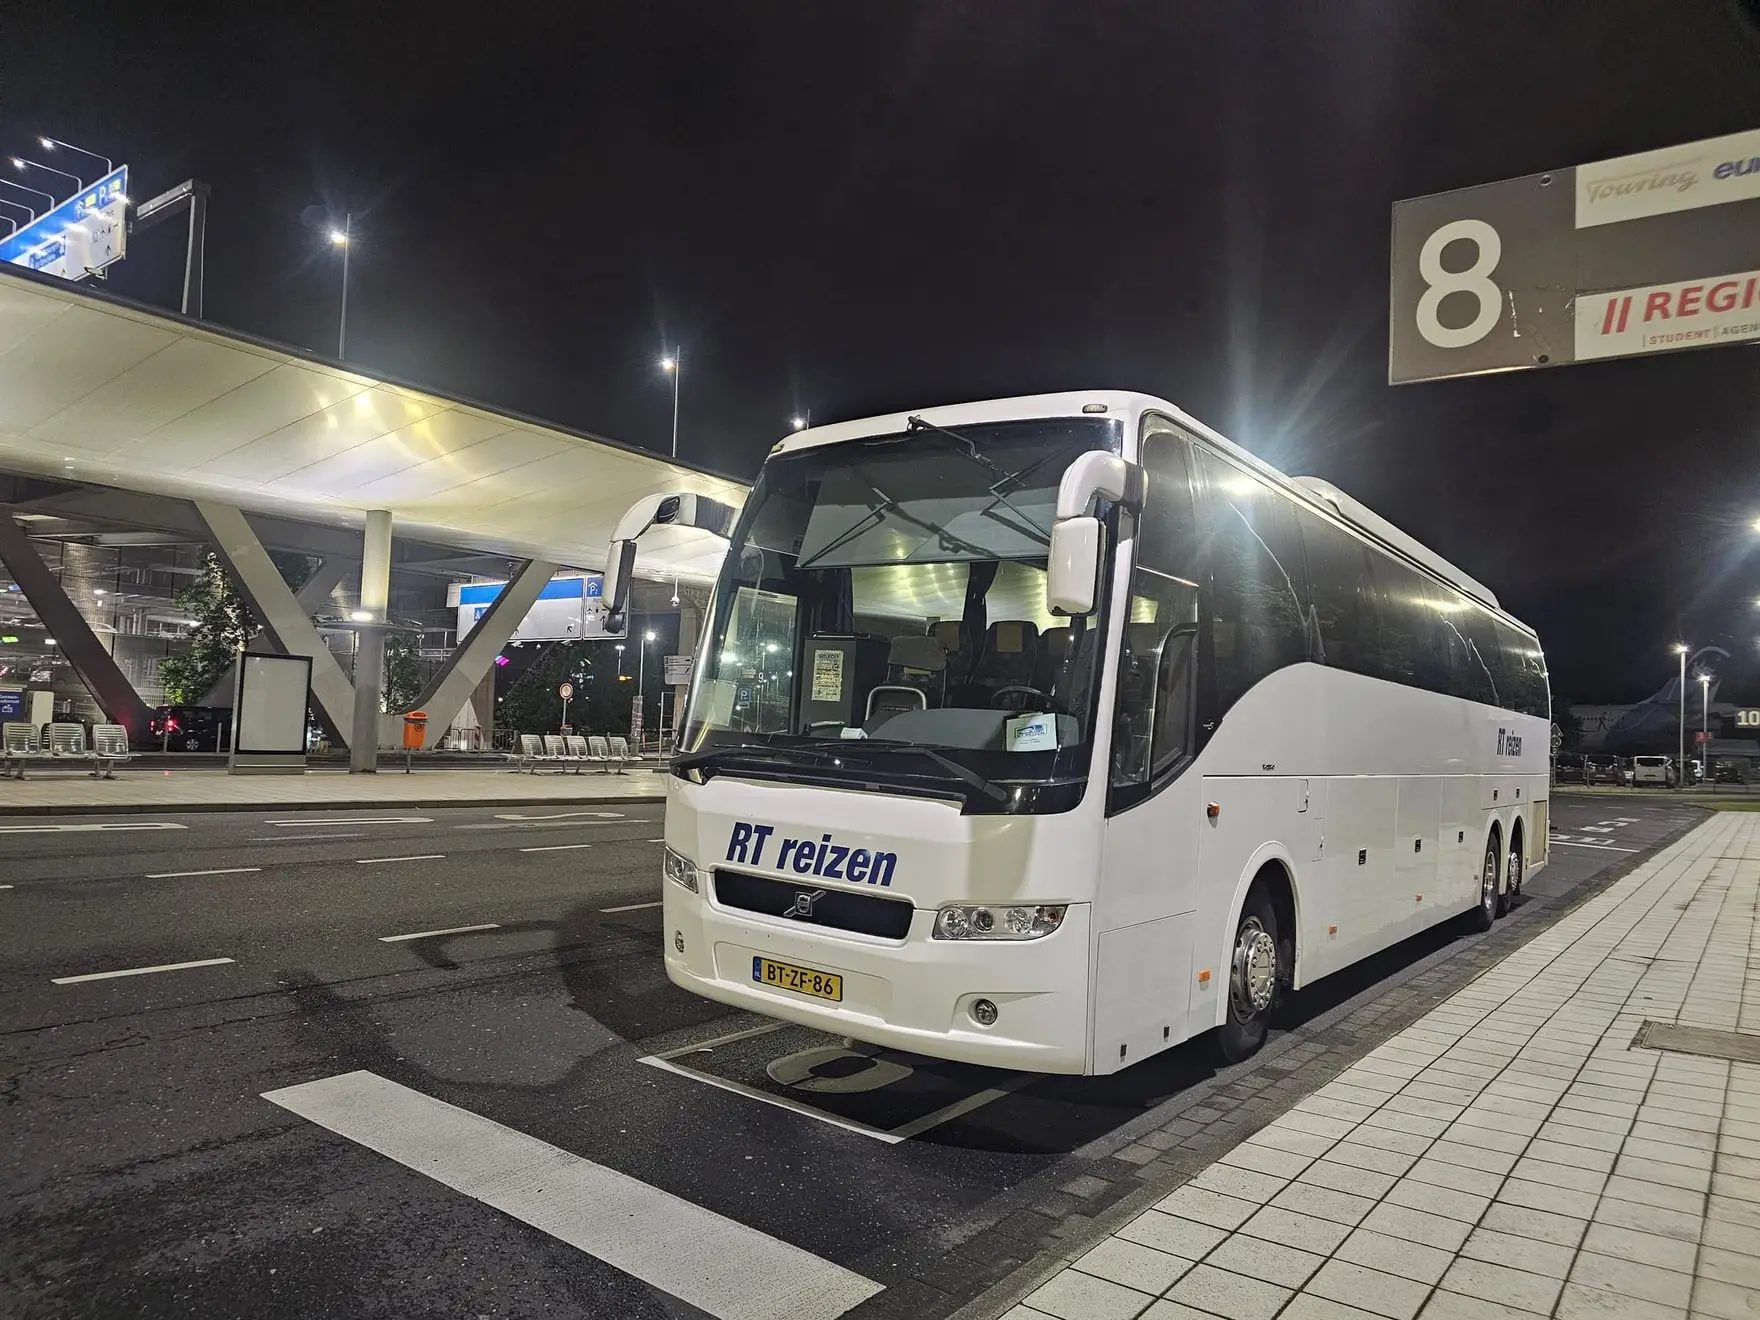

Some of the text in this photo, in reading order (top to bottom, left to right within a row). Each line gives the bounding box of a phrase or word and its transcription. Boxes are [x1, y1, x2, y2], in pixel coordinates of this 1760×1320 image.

[1586, 171, 1699, 203] Touring
[1416, 219, 1502, 348] 8
[1643, 278, 1760, 322] REGI
[1649, 328, 1713, 345] STUDENT
[1737, 710, 1760, 726] 10
[1497, 727, 1522, 757] RT reizen
[725, 821, 898, 887] RT reizen
[767, 963, 833, 995] BT-ZF-86
